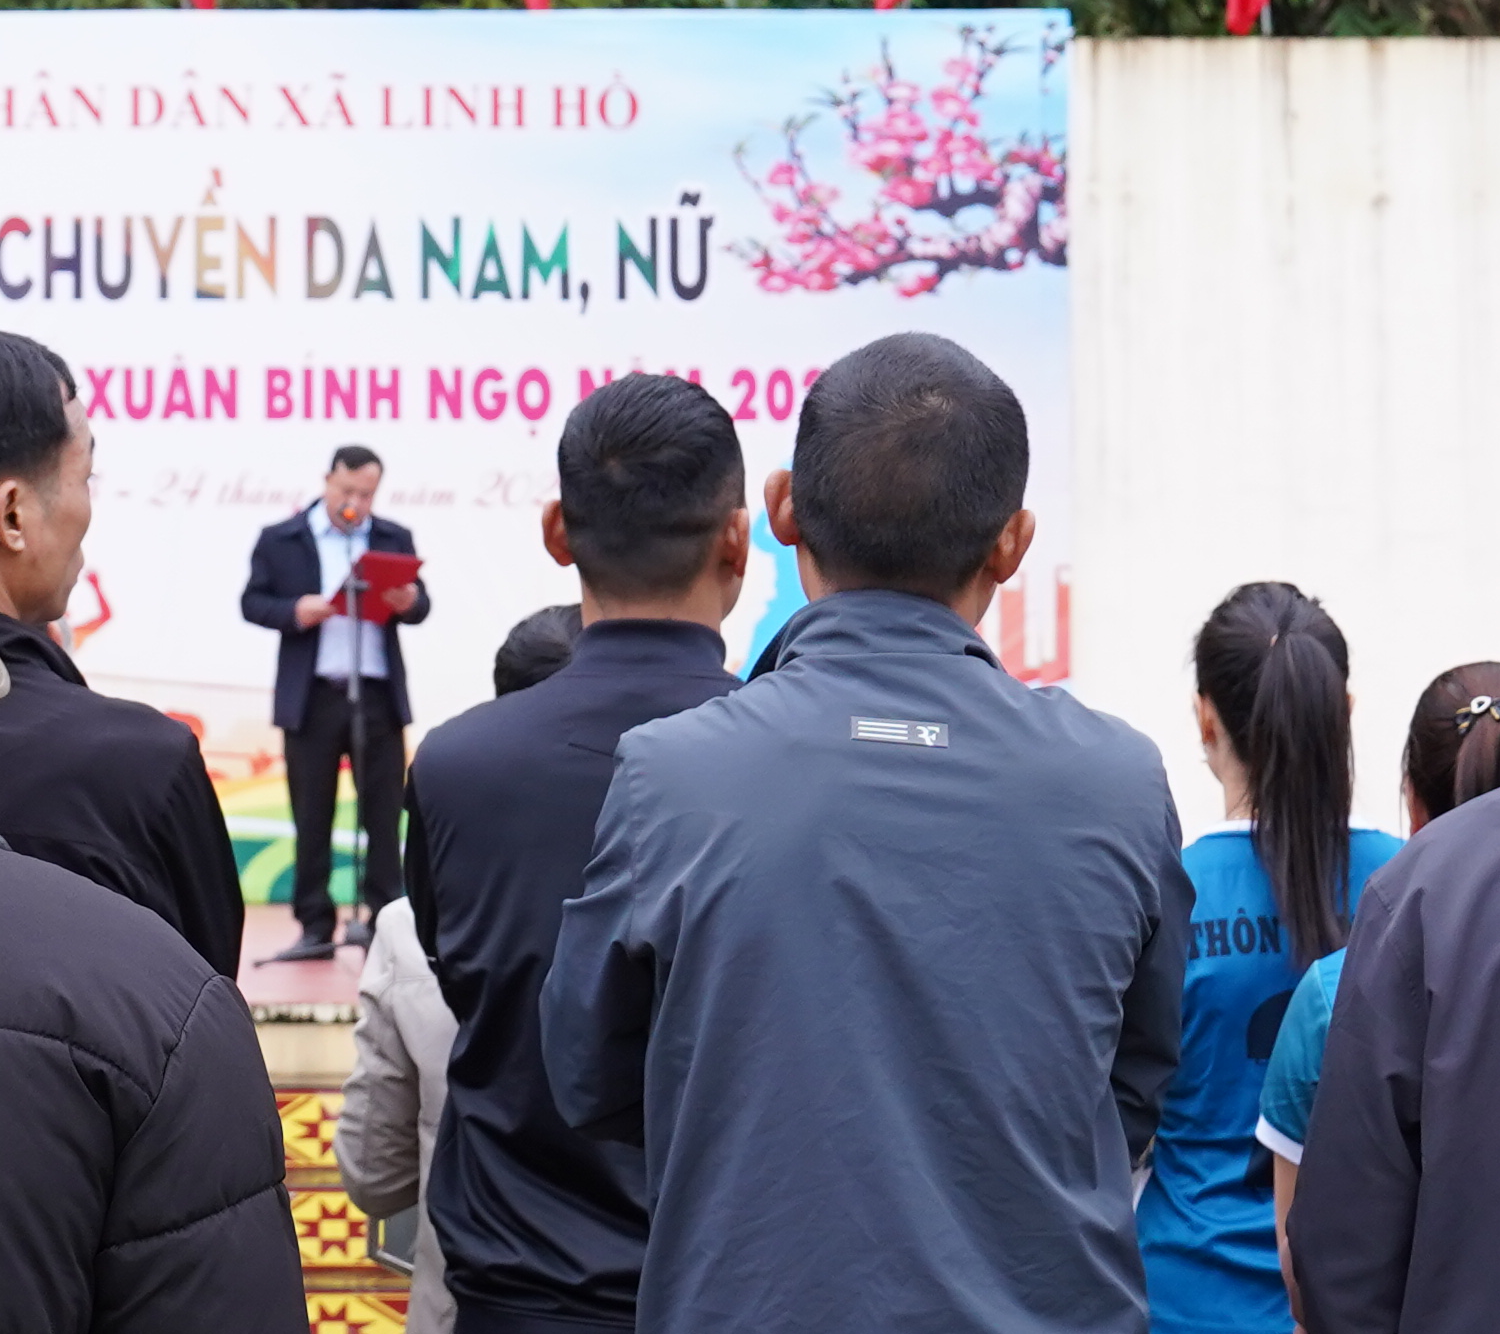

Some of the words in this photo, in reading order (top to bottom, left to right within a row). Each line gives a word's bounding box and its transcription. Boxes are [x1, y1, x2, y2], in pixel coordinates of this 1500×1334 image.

[130, 68, 252, 130] DÂN
[277, 72, 357, 130] XÃ
[381, 86, 526, 130] LINH
[305, 215, 396, 301] DA
[419, 215, 591, 315] NAM,
[616, 190, 716, 303] NỮ
[85, 352, 238, 420] XUÂN
[427, 368, 552, 437] NGỌ
[1186, 906, 1281, 960] THÔN
